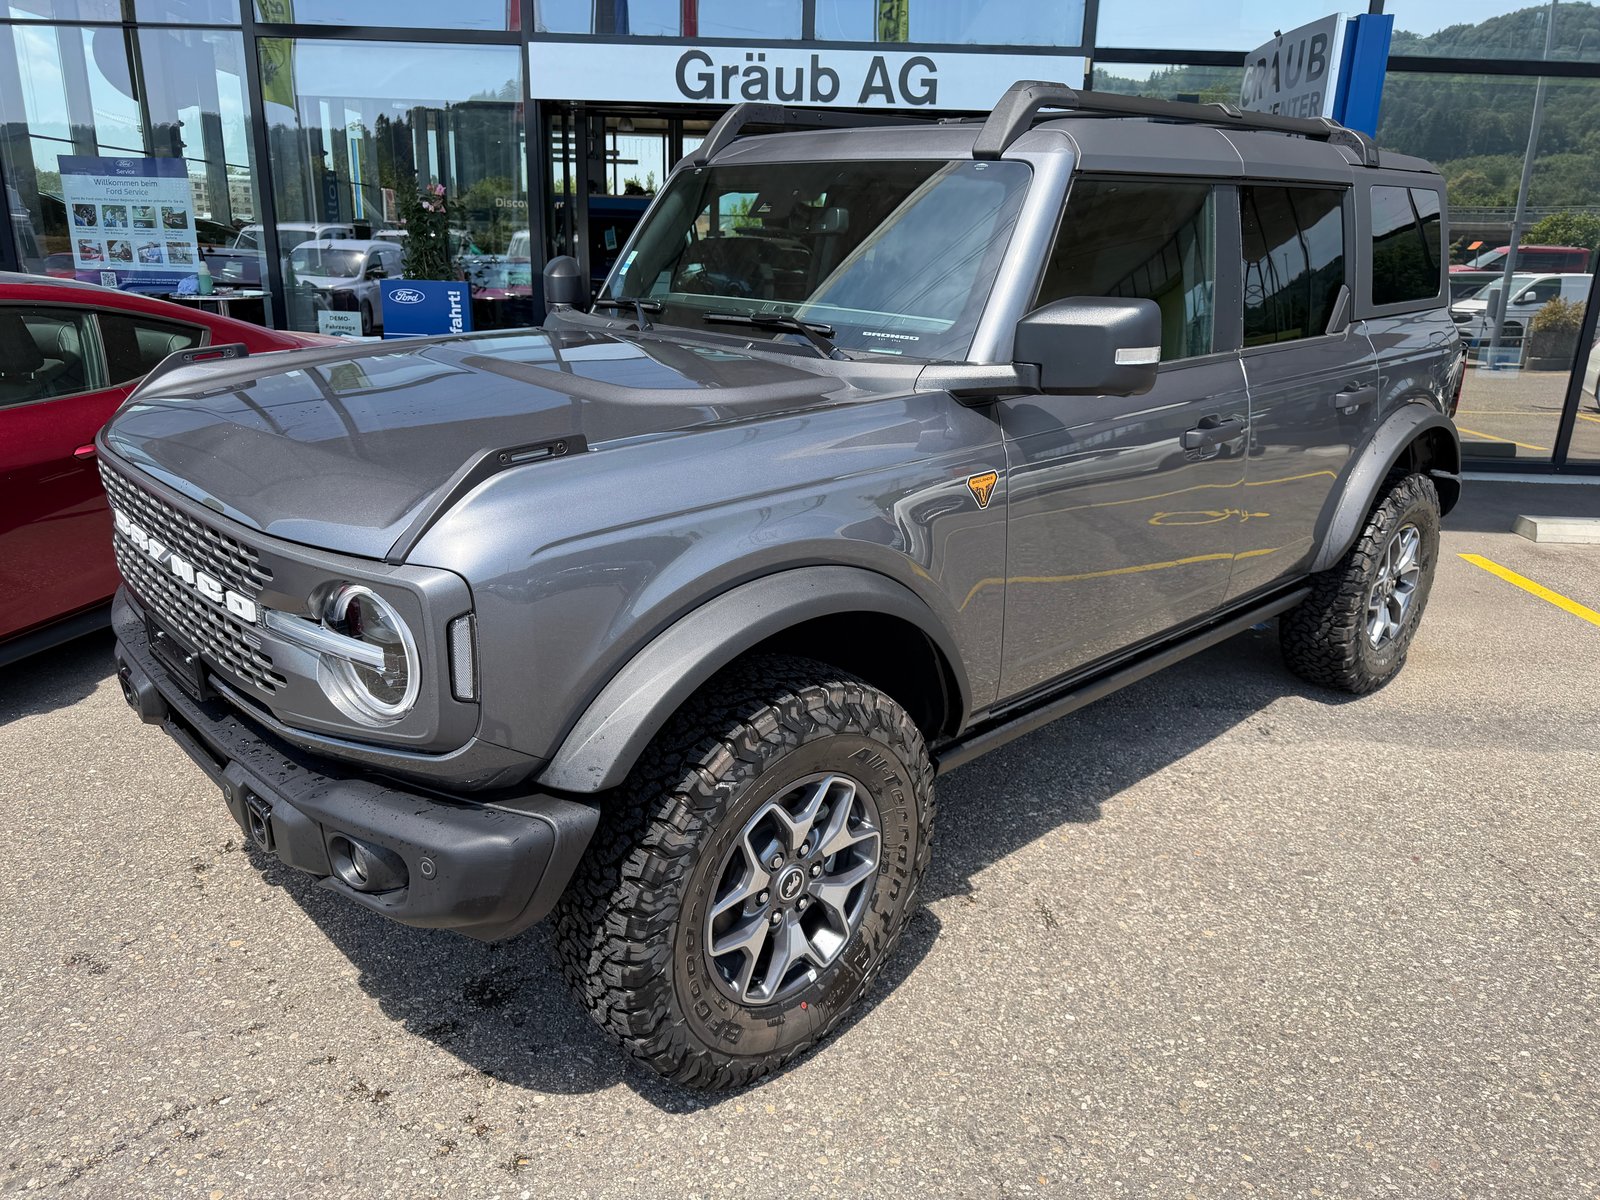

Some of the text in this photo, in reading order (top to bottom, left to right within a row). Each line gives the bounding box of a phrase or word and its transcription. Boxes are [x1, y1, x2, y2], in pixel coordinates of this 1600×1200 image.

[675, 49, 938, 106] Gräub AG
[1268, 91, 1321, 118] ENTER
[93, 178, 158, 188] Willkommen beim
[393, 290, 421, 302] Ford
[325, 323, 356, 331] Fahrzeuge
[862, 331, 920, 341] BRONCO
[115, 508, 257, 623] BRONCO
